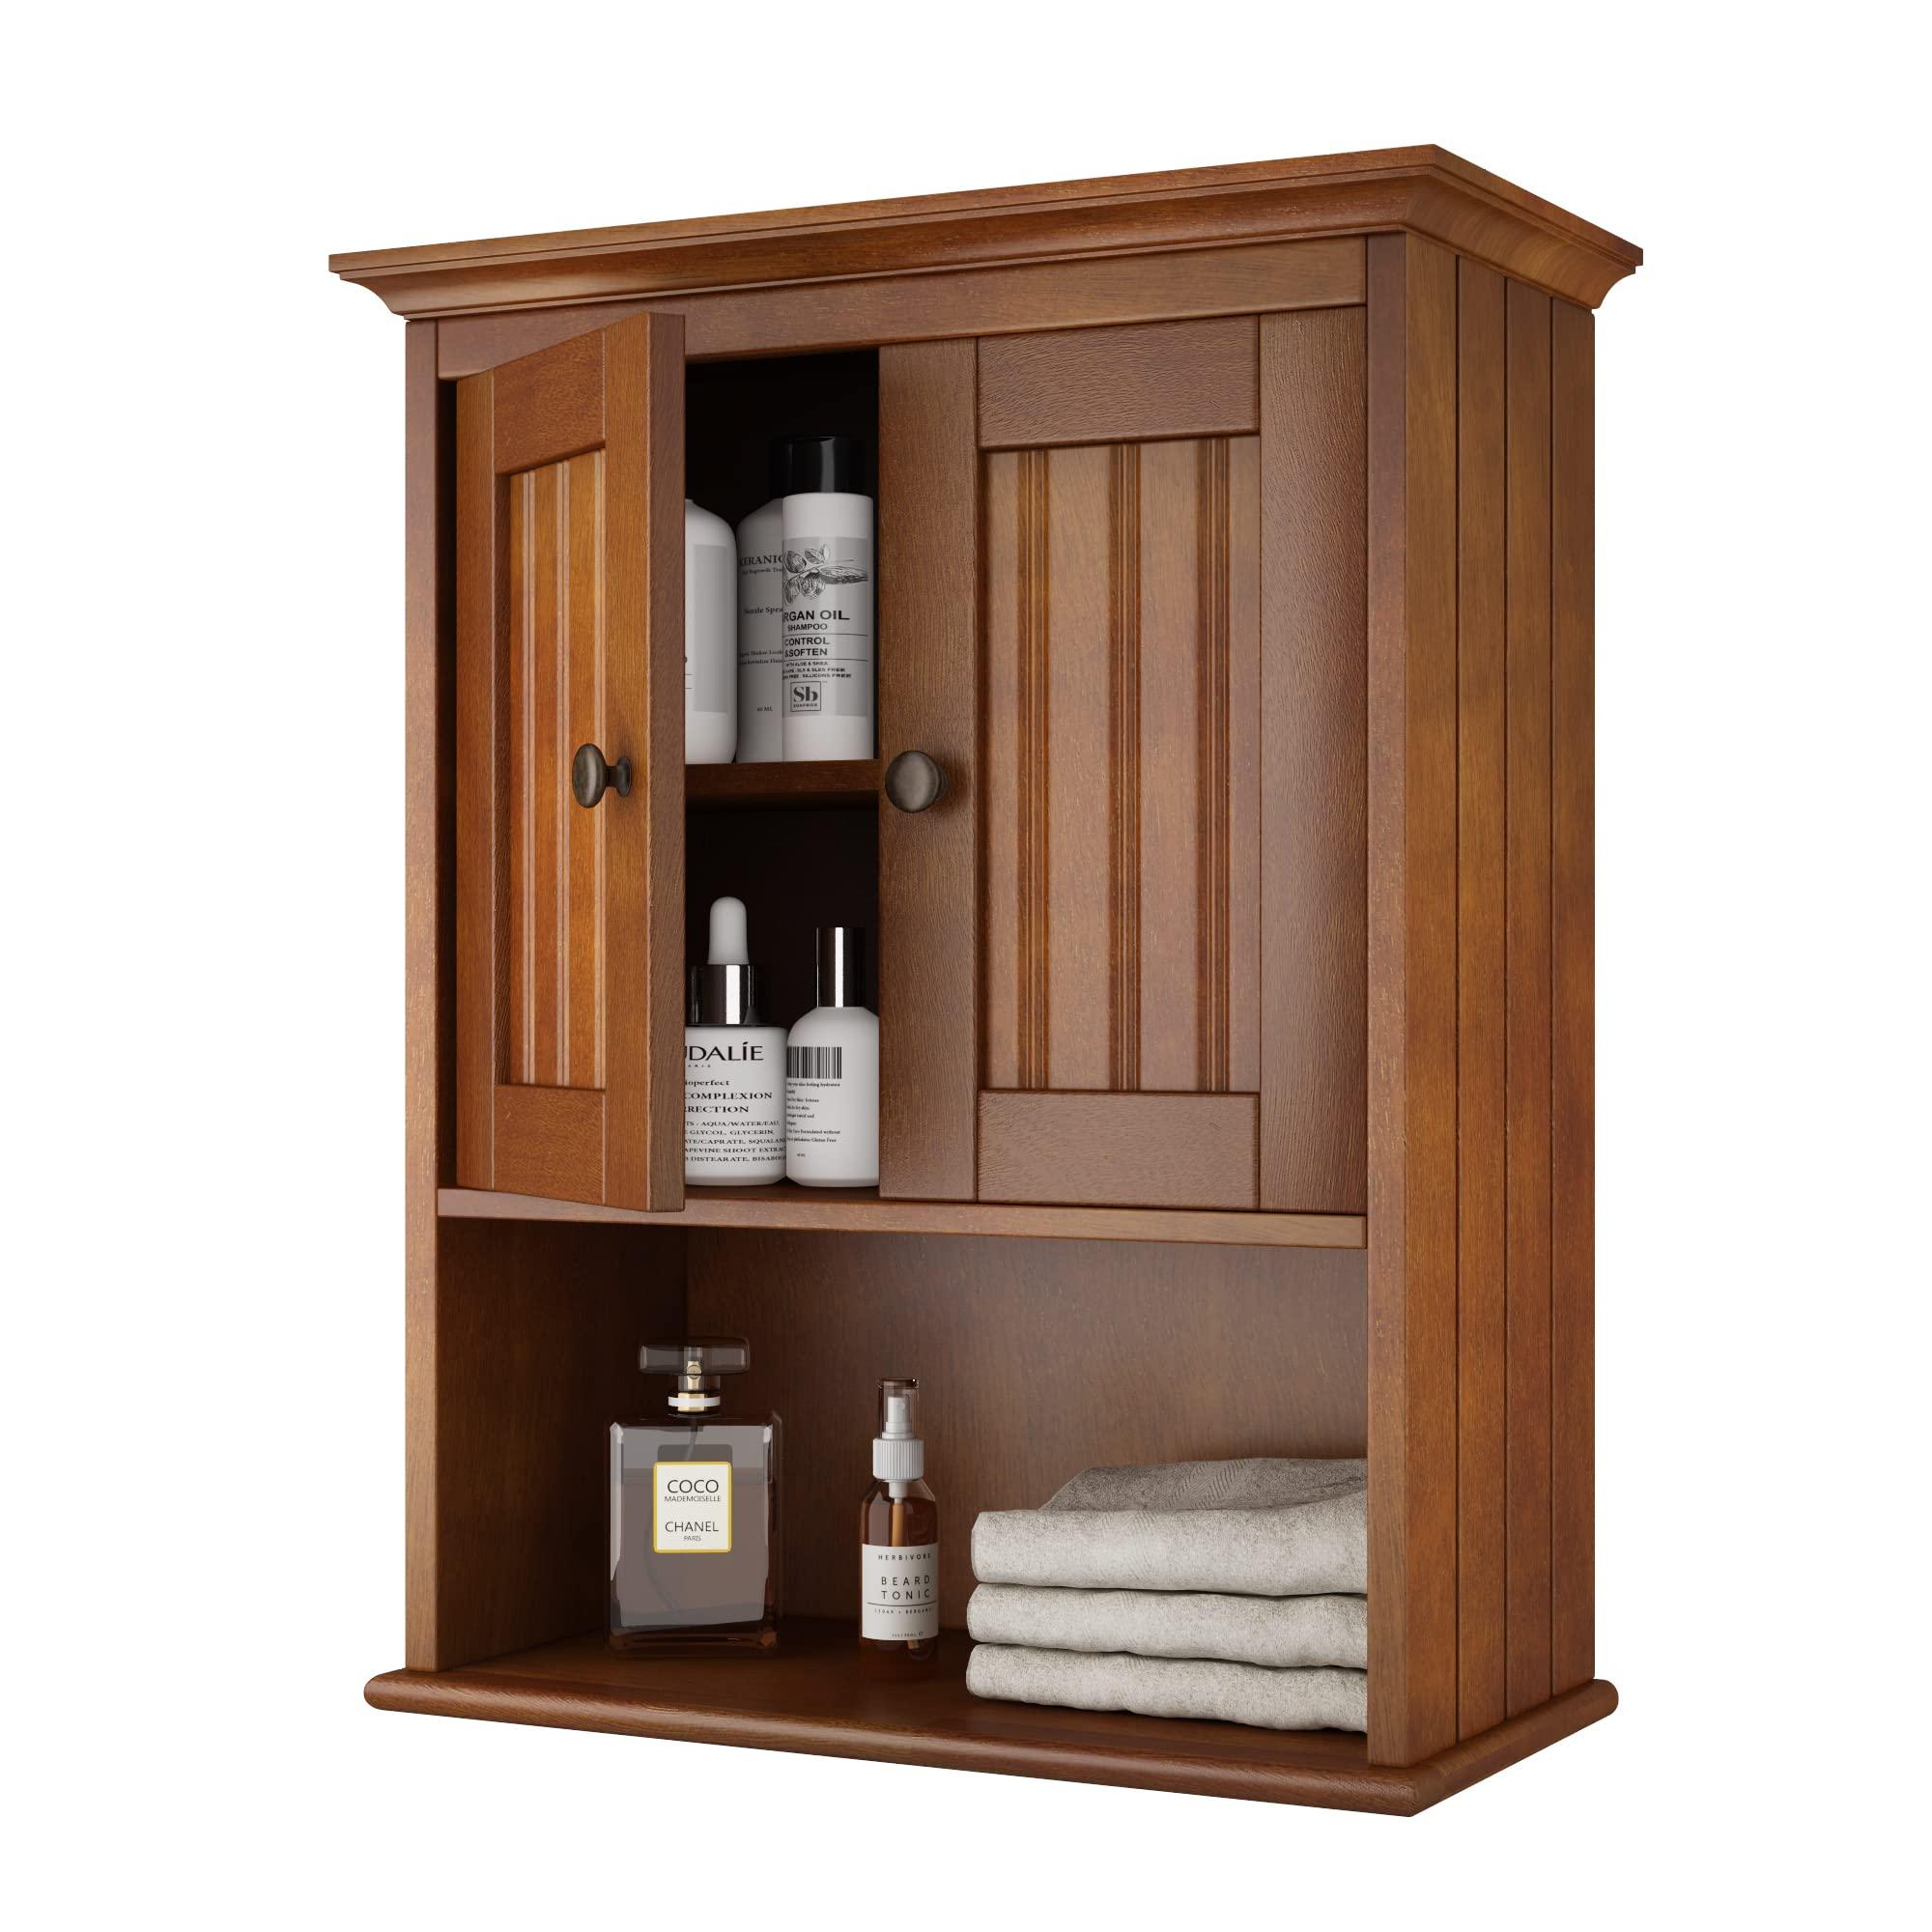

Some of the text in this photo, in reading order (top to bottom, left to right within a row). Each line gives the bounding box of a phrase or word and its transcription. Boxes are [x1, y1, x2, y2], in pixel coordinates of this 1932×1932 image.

[782, 610, 850, 622] RGAN OIL
[787, 623, 828, 632] SHAMPOO
[784, 637, 830, 646] CONTROL
[793, 686, 819, 702] Sb
[668, 1479, 720, 1493] COCO
[665, 1520, 720, 1532] CHANEL
[878, 1552, 931, 1561] HERBIVORE
[881, 1575, 931, 1586] BEARD
[880, 1589, 930, 1601] TONIC
